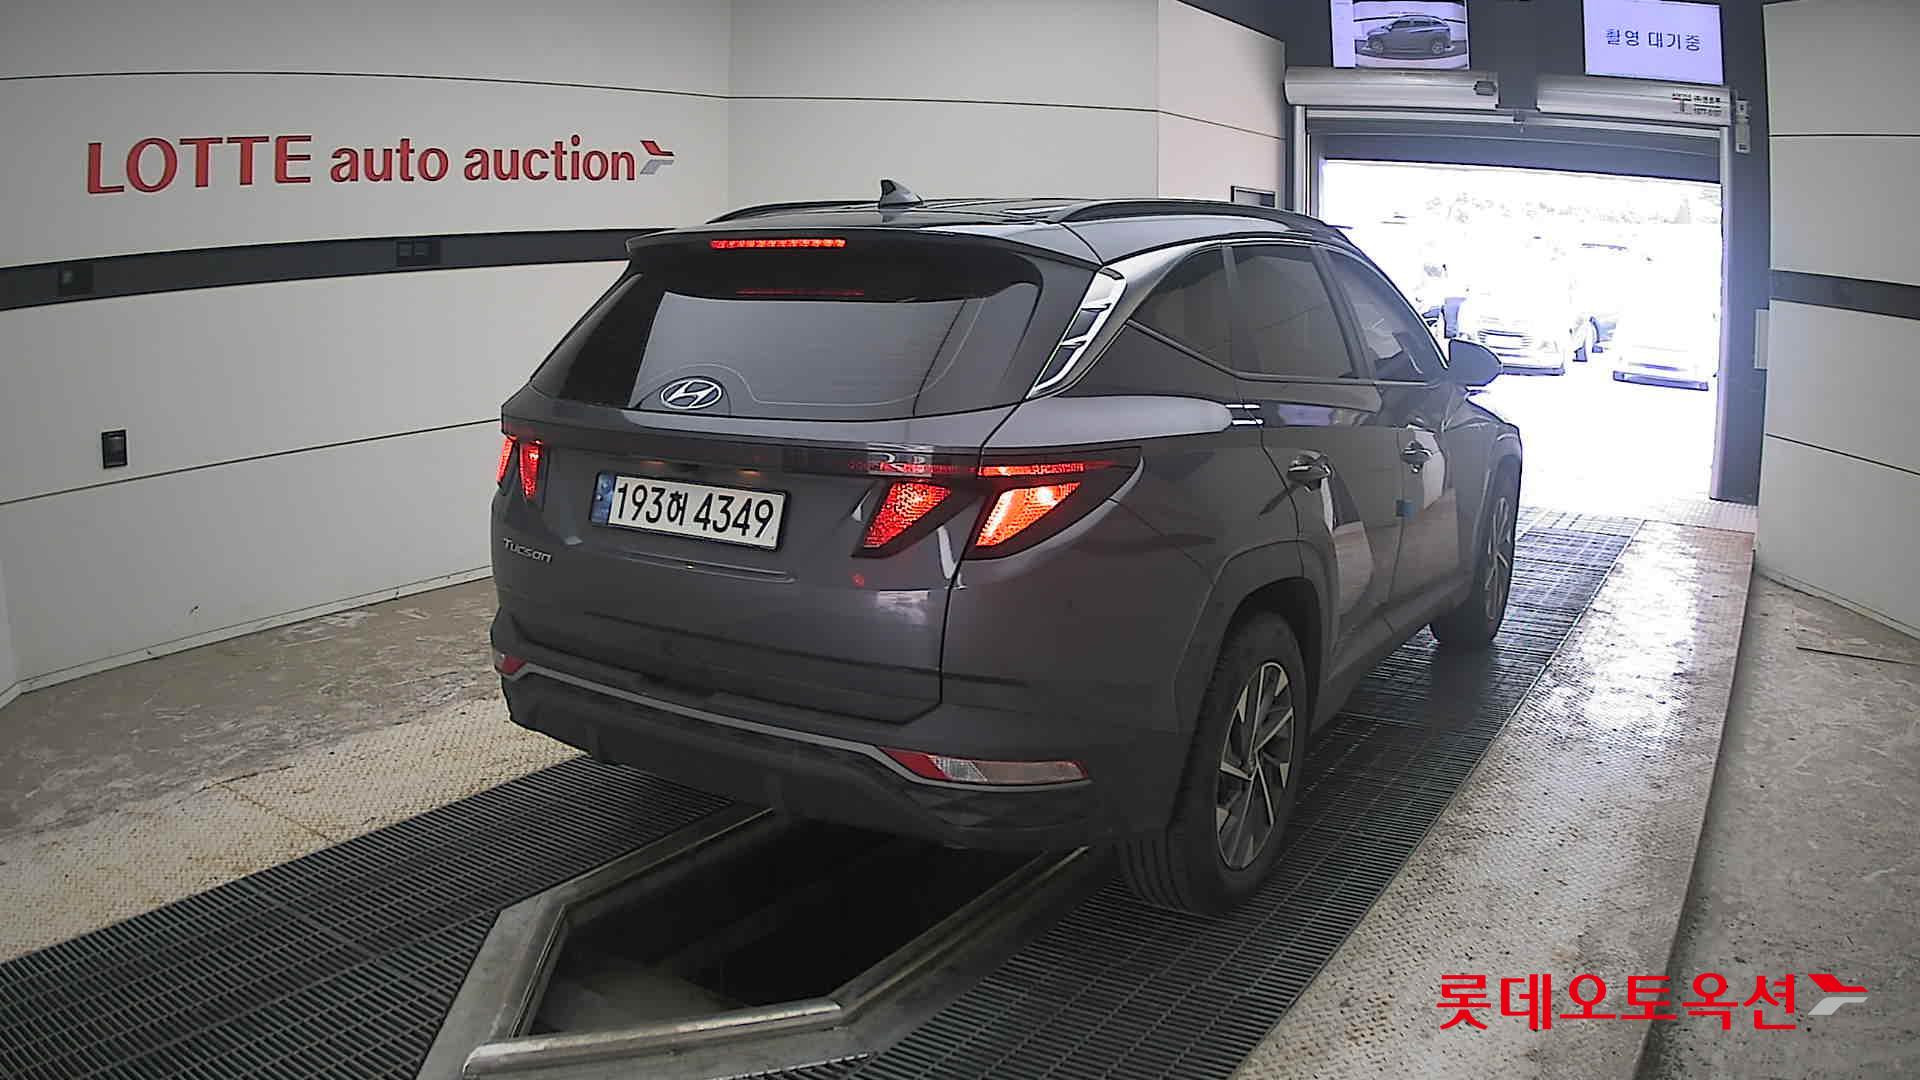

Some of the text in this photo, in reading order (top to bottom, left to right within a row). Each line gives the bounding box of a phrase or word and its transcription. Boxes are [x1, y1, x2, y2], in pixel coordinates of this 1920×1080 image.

[88, 136, 635, 193] LOTTE auto auction
[693, 492, 774, 538] 4349
